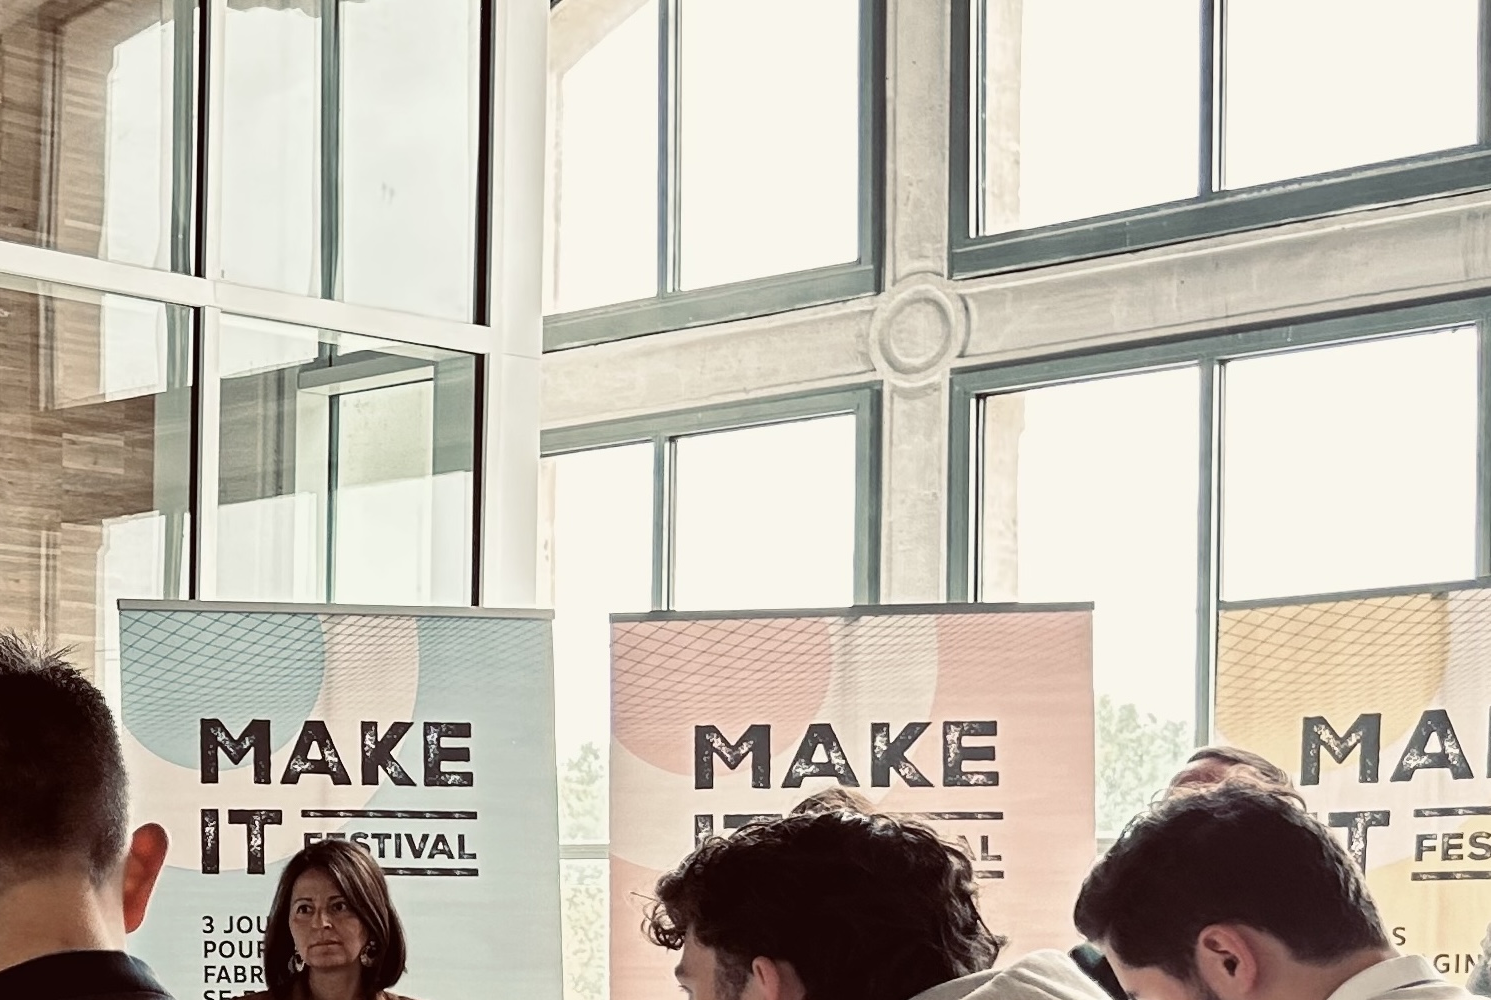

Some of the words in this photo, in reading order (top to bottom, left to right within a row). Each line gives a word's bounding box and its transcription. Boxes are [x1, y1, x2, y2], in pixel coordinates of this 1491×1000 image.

[199, 718, 474, 788] MAKE
[693, 720, 1000, 790] MAKE
[1300, 706, 1491, 787] MA
[199, 808, 283, 875] IT
[202, 915, 214, 934] 3
[223, 915, 270, 934] JOU
[204, 965, 264, 983] FABR
